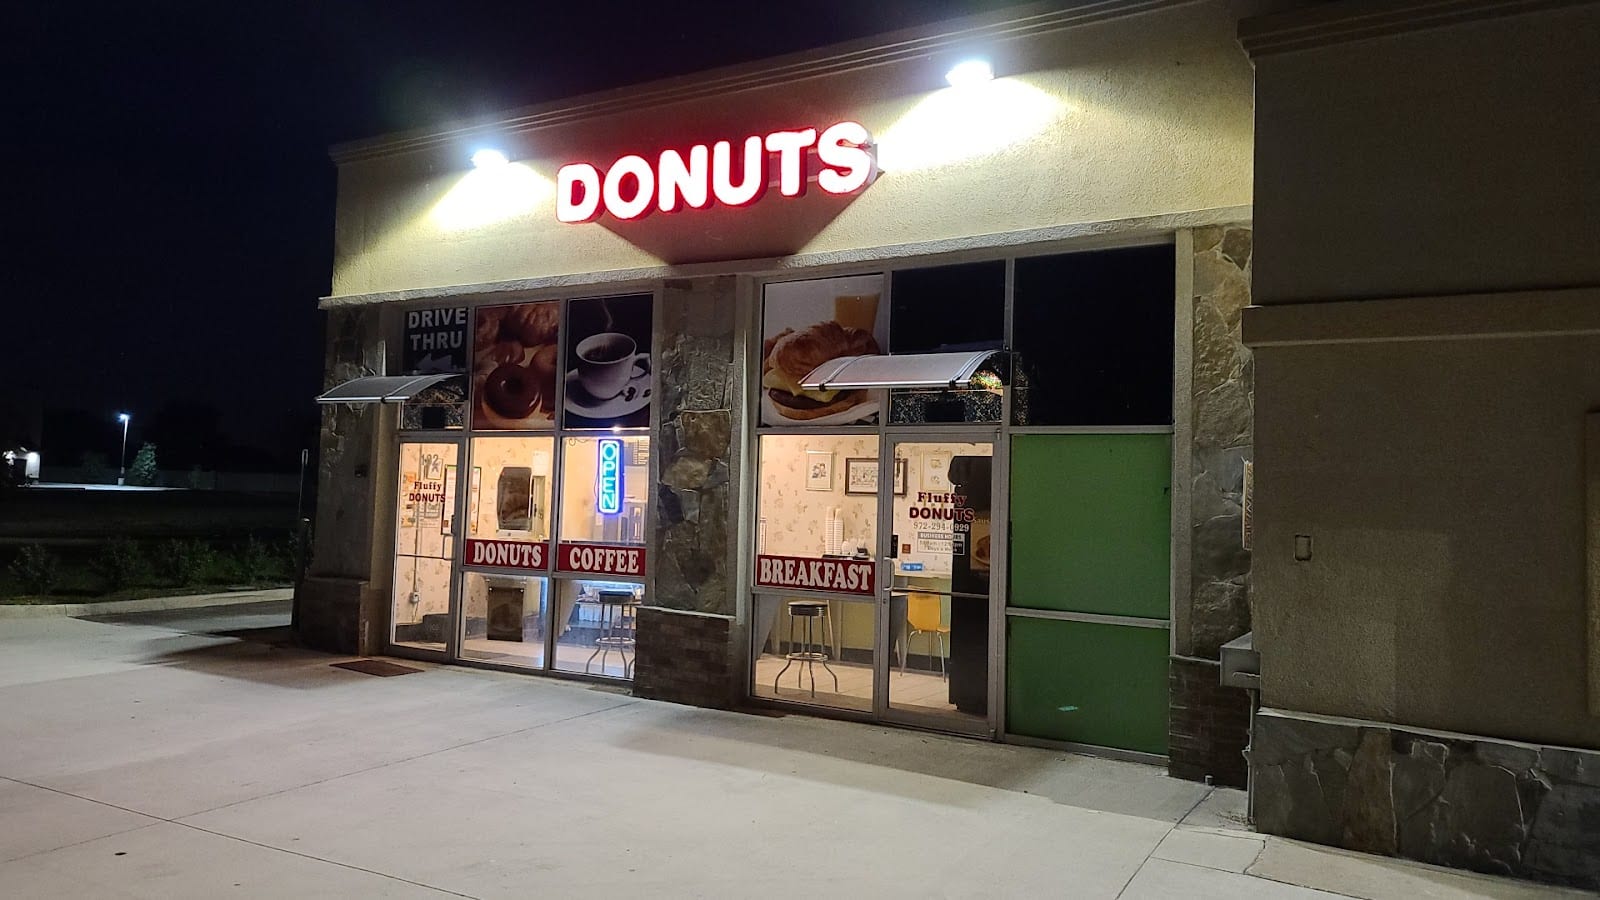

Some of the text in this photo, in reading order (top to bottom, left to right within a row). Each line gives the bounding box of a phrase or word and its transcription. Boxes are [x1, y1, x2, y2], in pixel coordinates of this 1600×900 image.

[556, 120, 874, 223] DONUTS
[408, 307, 467, 329] DRIVE
[409, 330, 463, 351] THRU
[414, 481, 442, 492] Fluffy
[602, 442, 617, 510] OPEN
[408, 493, 446, 503] DONUTS
[917, 491, 968, 507] Fluffy
[909, 506, 976, 522] DONUTS
[473, 541, 542, 567] DONUTS
[569, 547, 640, 574] COFFEE
[759, 557, 872, 591] BREAKFAST
